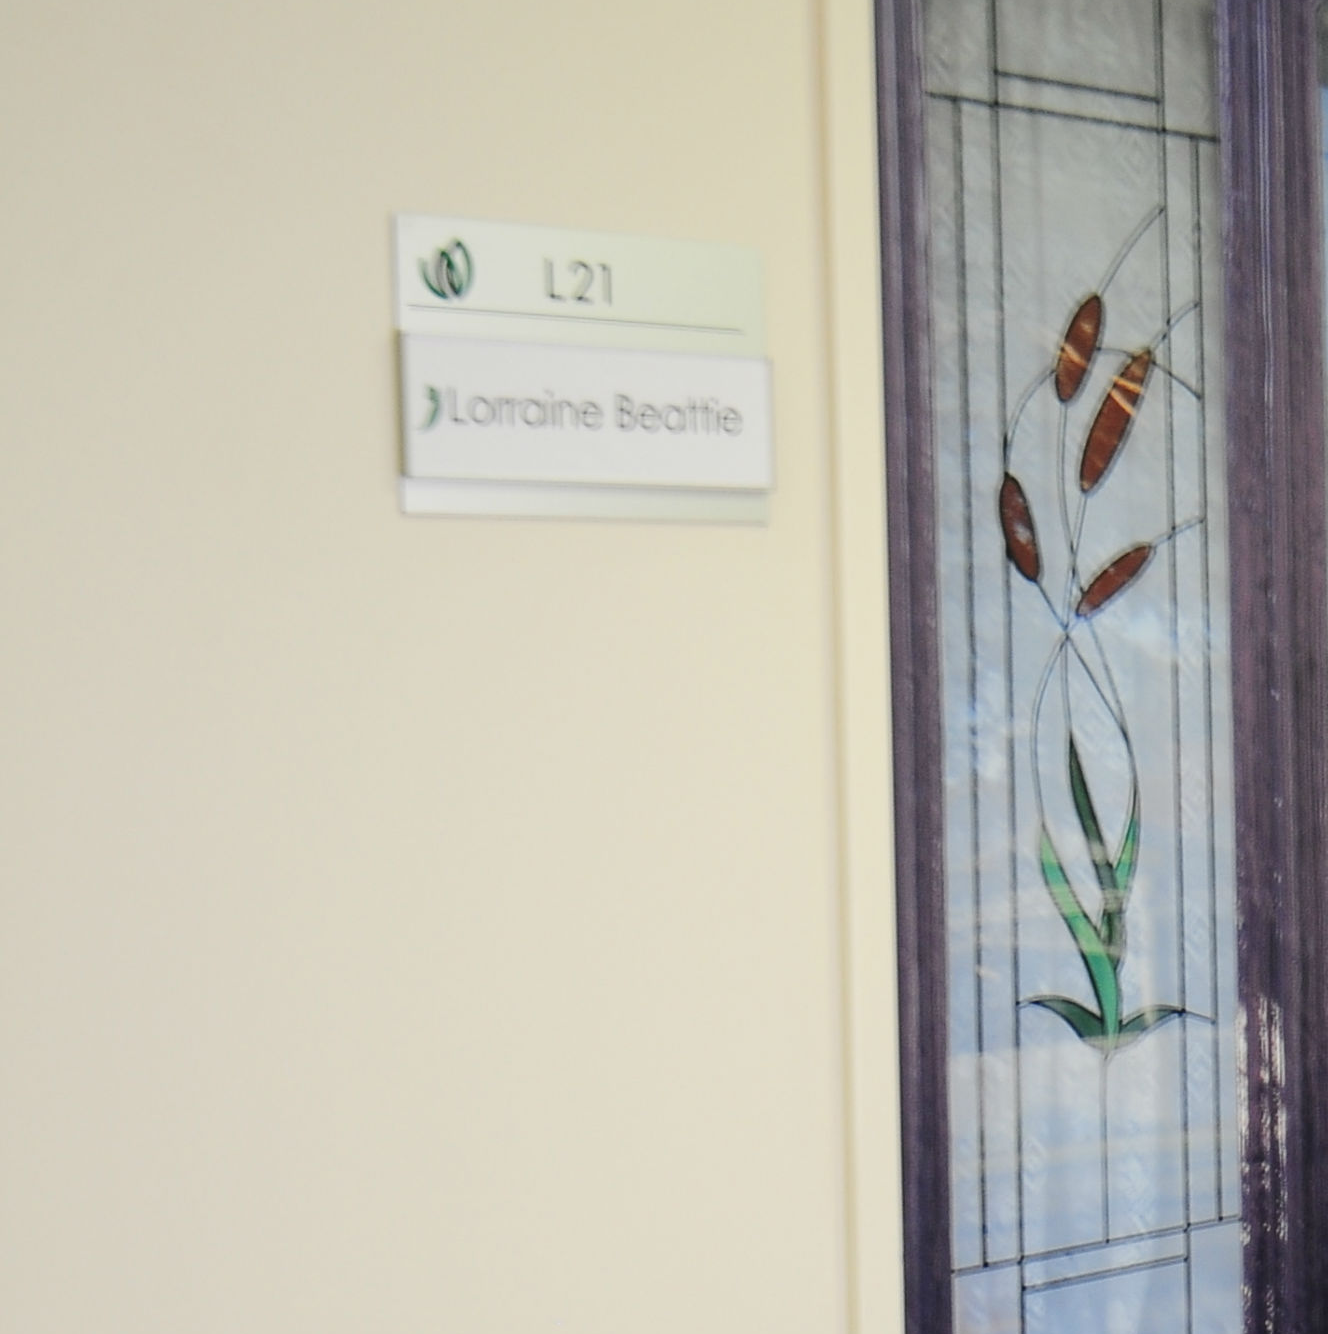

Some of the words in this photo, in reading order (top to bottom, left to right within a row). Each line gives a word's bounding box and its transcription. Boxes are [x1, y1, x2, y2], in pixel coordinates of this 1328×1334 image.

[543, 257, 613, 306] L21
[447, 387, 603, 430] Lorraine
[613, 392, 744, 437] Beattie
